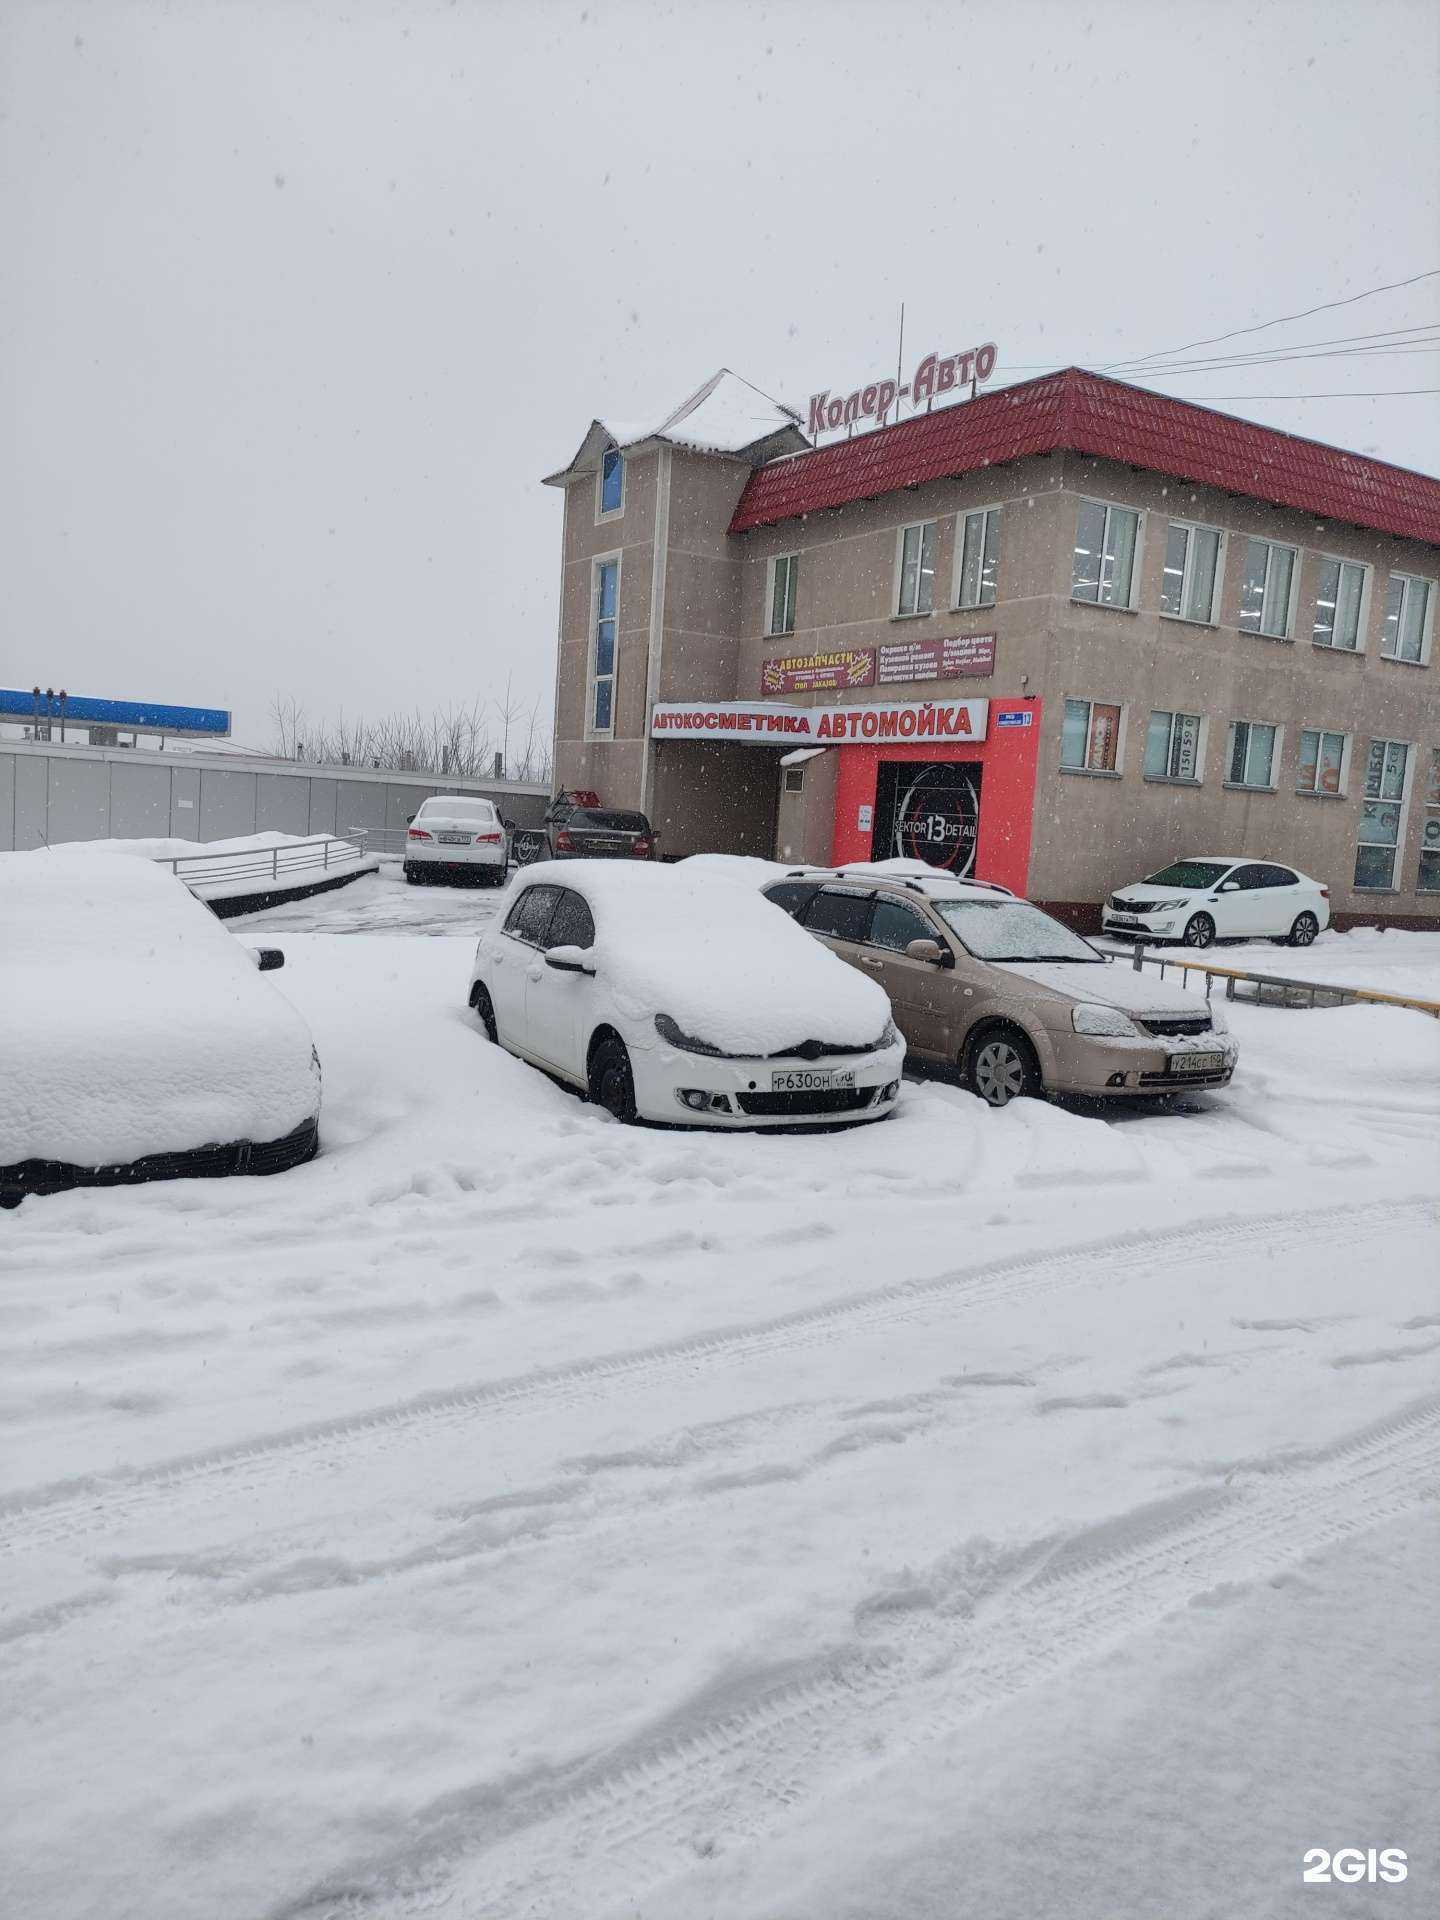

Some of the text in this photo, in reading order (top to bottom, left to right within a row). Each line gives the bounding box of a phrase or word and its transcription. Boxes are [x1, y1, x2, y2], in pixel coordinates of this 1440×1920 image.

[808, 341, 998, 436] Колер-Авто
[880, 645, 908, 655] Окраска
[943, 636, 993, 648] Подбор цвета
[780, 652, 854, 670] АВТОЗАПЧАСТИ
[653, 712, 811, 734] АВТОКОСМЕТИКА
[816, 703, 972, 738] АВТОМОЙКА
[894, 815, 977, 842] SEKTOR 13 DETAIL
[777, 1073, 830, 1090] Р630ОН
